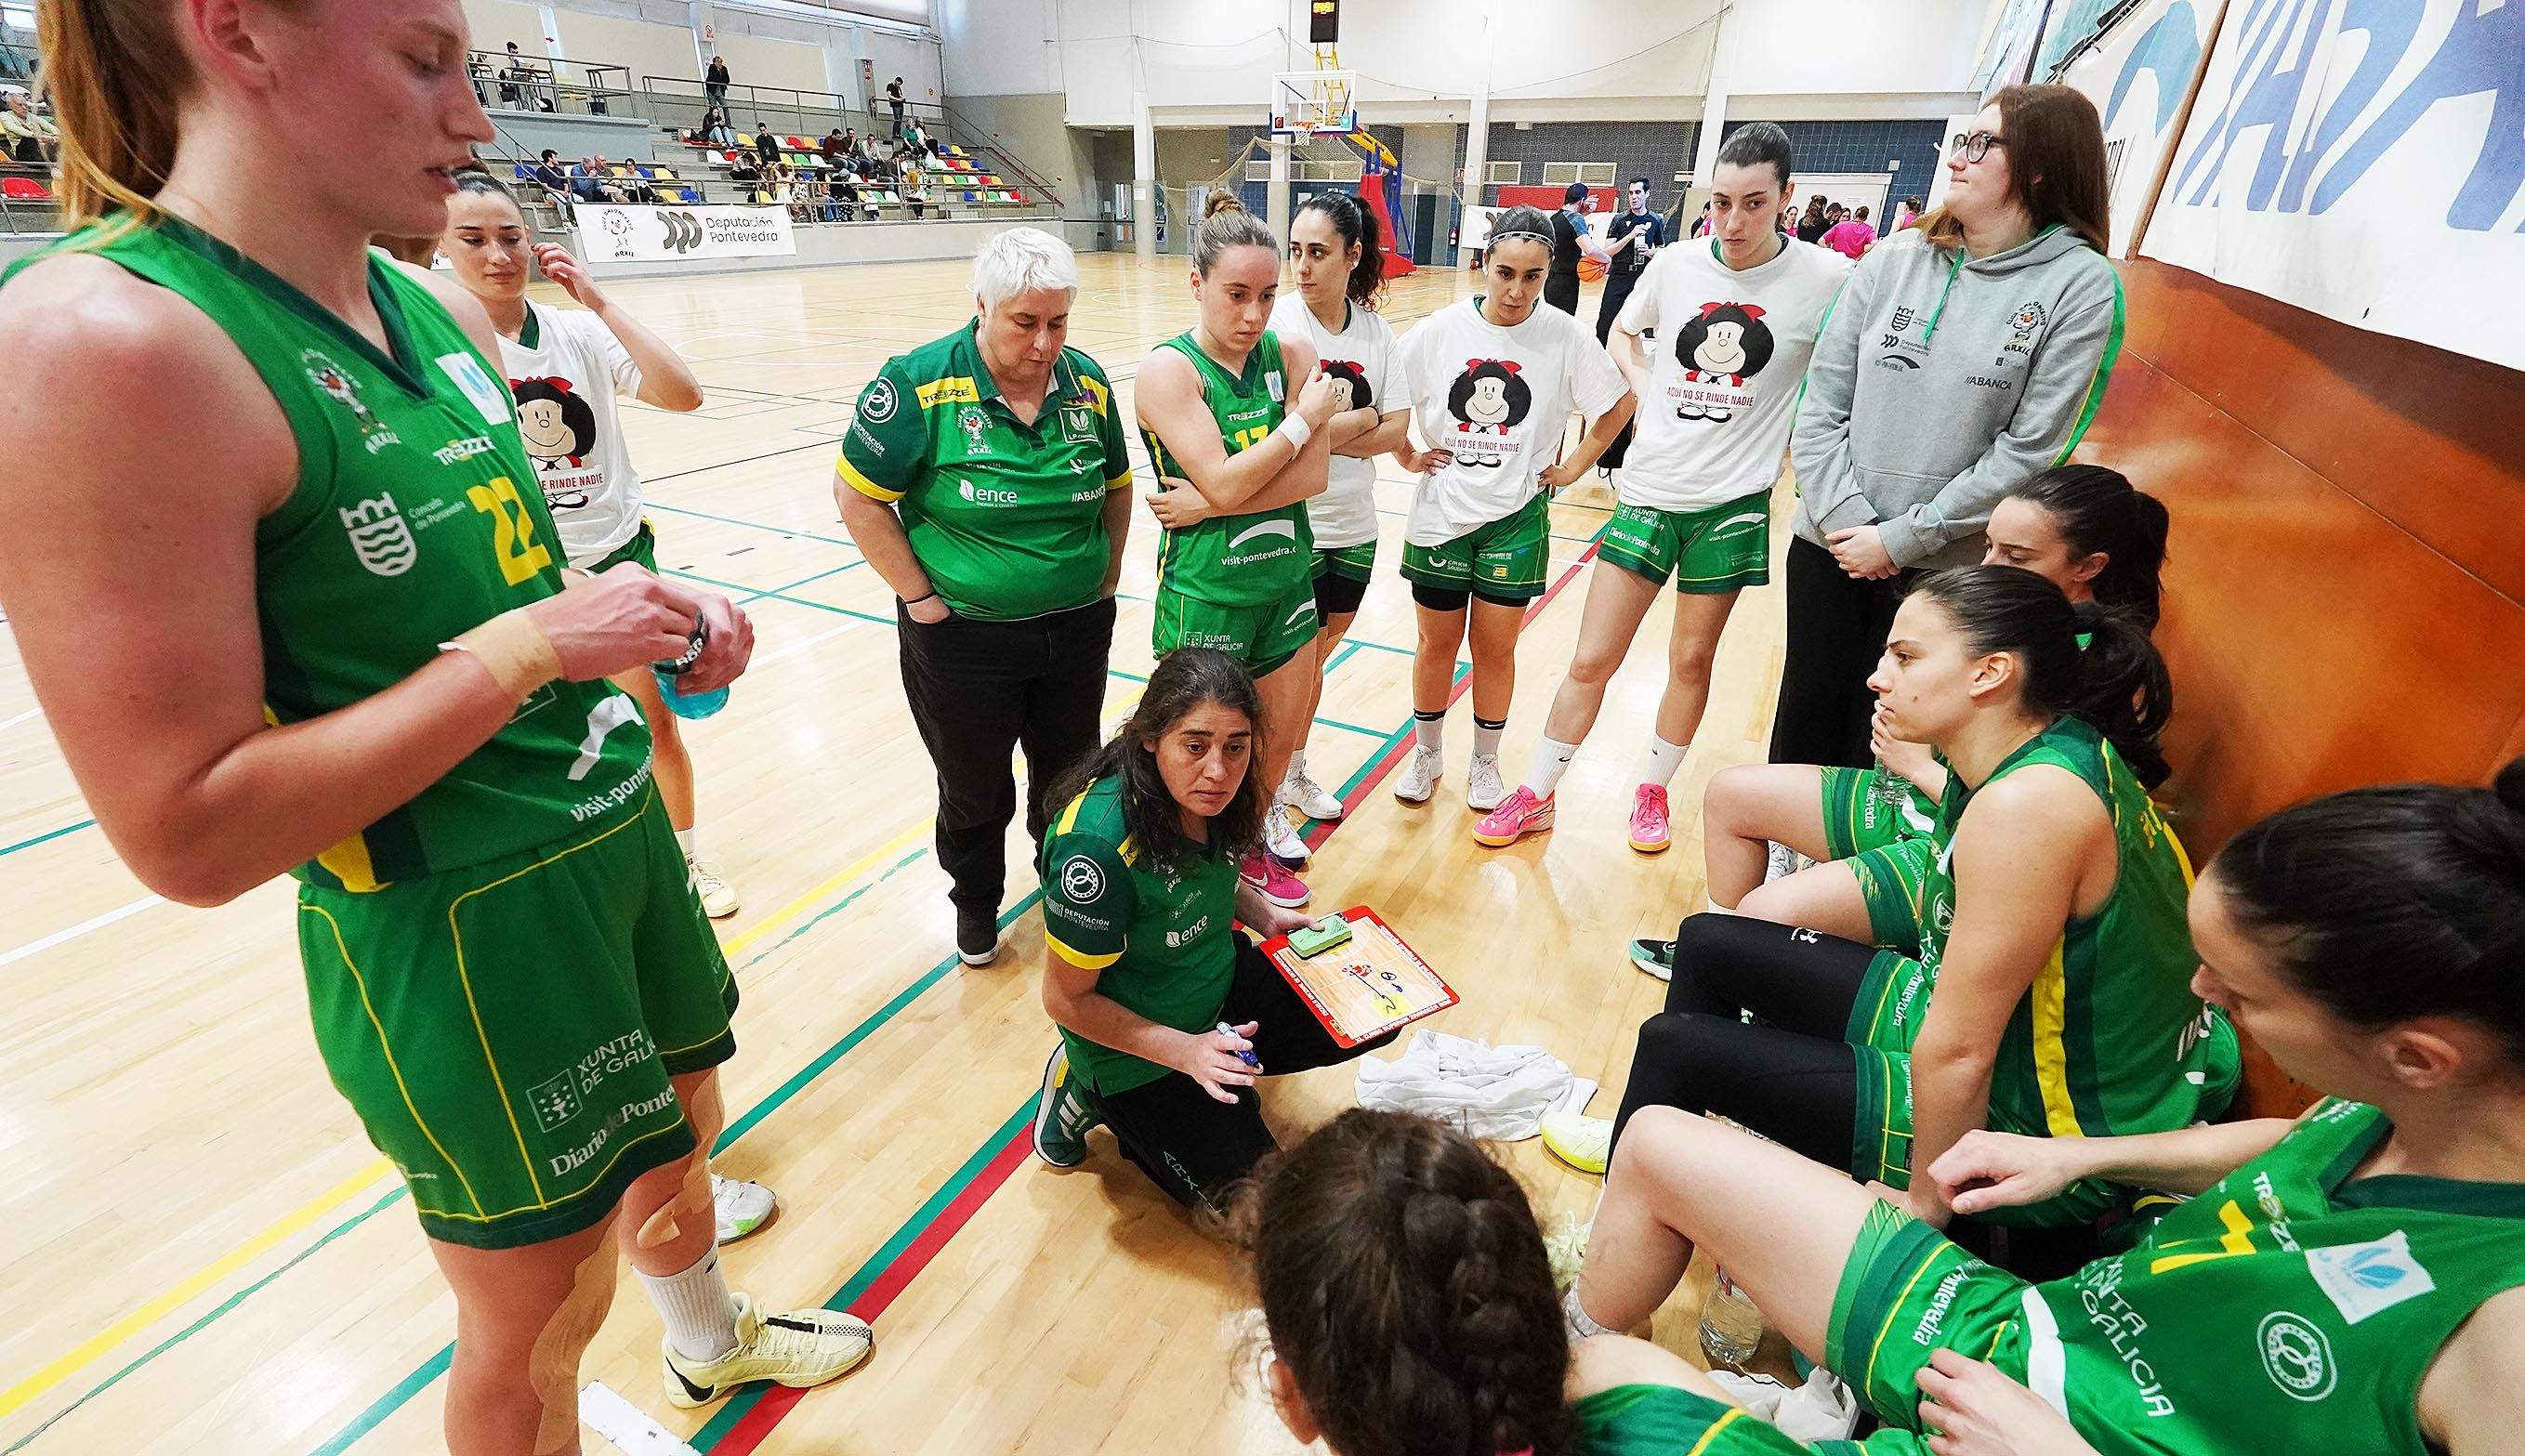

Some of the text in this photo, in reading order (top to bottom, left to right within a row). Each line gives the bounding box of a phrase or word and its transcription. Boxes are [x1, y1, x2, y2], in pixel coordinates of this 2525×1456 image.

[705, 216, 775, 231] Deputación
[710, 230, 779, 243] Pontevedra
[2004, 344, 2032, 356] ARXIL
[1682, 389, 1692, 400] NO
[1694, 390, 1704, 400] SE
[1705, 391, 1729, 404] RINDE
[1730, 394, 1755, 407] NADIE
[1457, 439, 1466, 448] NO
[1468, 439, 1477, 449] SE
[1478, 440, 1498, 451] RINDE
[1499, 442, 1520, 453] NADIE
[549, 476, 577, 490] RINDE
[579, 472, 604, 487] NADIE
[977, 488, 1019, 505] ence
[1629, 513, 1641, 521] DE
[1203, 634, 1231, 643] XUNTA
[1064, 907, 1111, 926] DEPUTACIÓN
[1180, 914, 1208, 941] ence
[577, 1029, 643, 1079] XUNTA
[582, 1072, 604, 1095] DE
